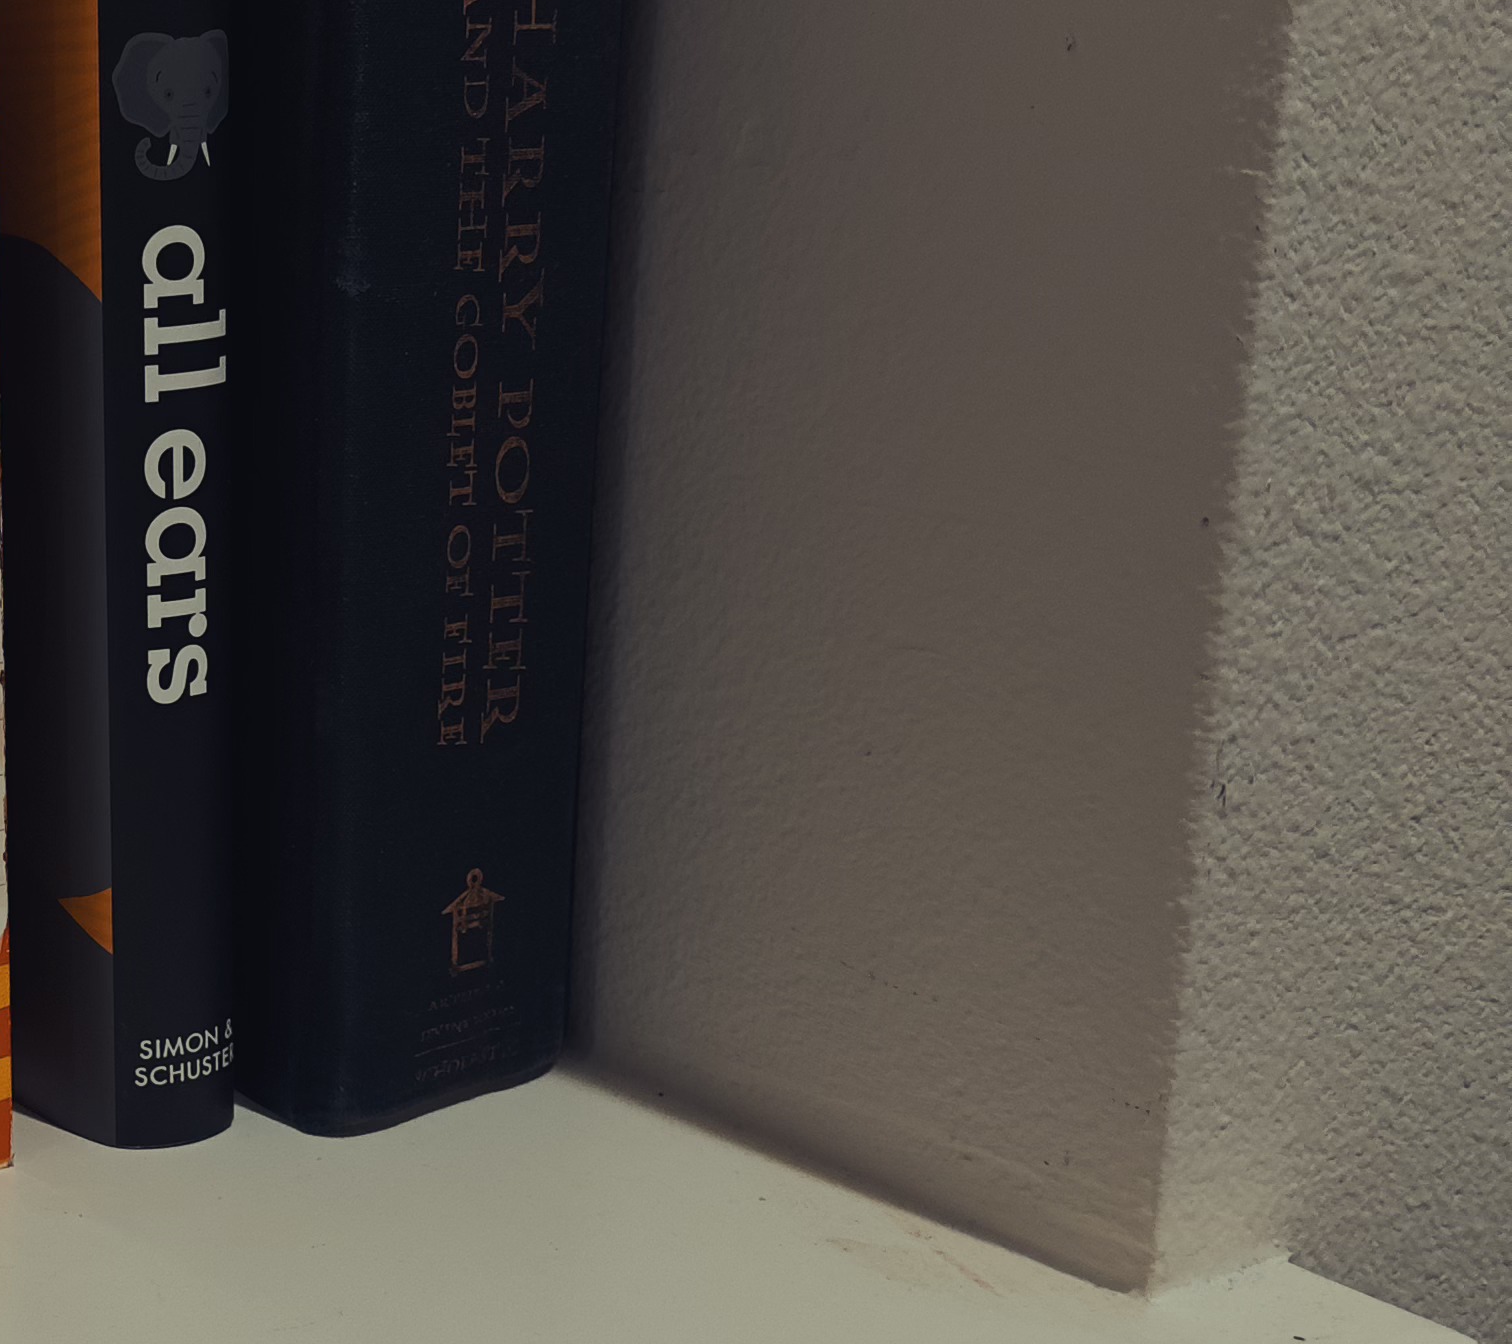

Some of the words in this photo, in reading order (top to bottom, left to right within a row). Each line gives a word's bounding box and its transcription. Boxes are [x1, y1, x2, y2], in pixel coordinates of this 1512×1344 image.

[453, 137, 490, 272] THE
[142, 224, 226, 403] all
[445, 293, 484, 507] GOBLET
[144, 429, 208, 705] ears
[445, 525, 474, 597] OF
[480, 378, 534, 745] POTTER
[437, 613, 472, 746] FIRE
[134, 1042, 233, 1087] SCHUSTER
[139, 1026, 218, 1060] SIMON
[225, 1019, 232, 1039] &
